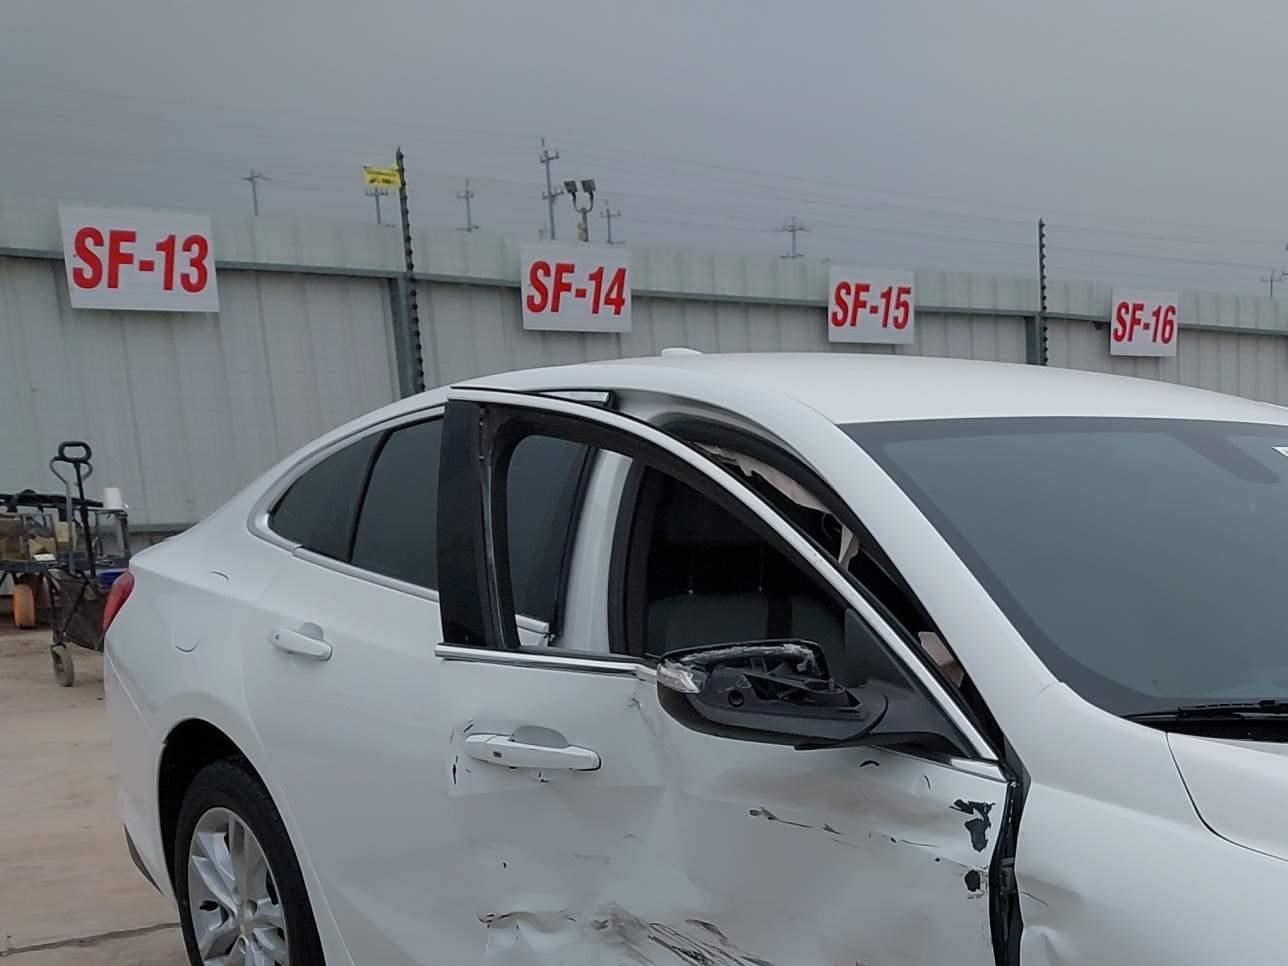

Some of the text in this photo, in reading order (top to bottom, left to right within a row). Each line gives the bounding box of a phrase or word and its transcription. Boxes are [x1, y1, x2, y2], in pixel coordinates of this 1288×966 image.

[72, 226, 209, 294] SF-13
[526, 260, 629, 316] SF-14
[830, 281, 914, 331] SF-15
[1111, 302, 1177, 345] SF-16
